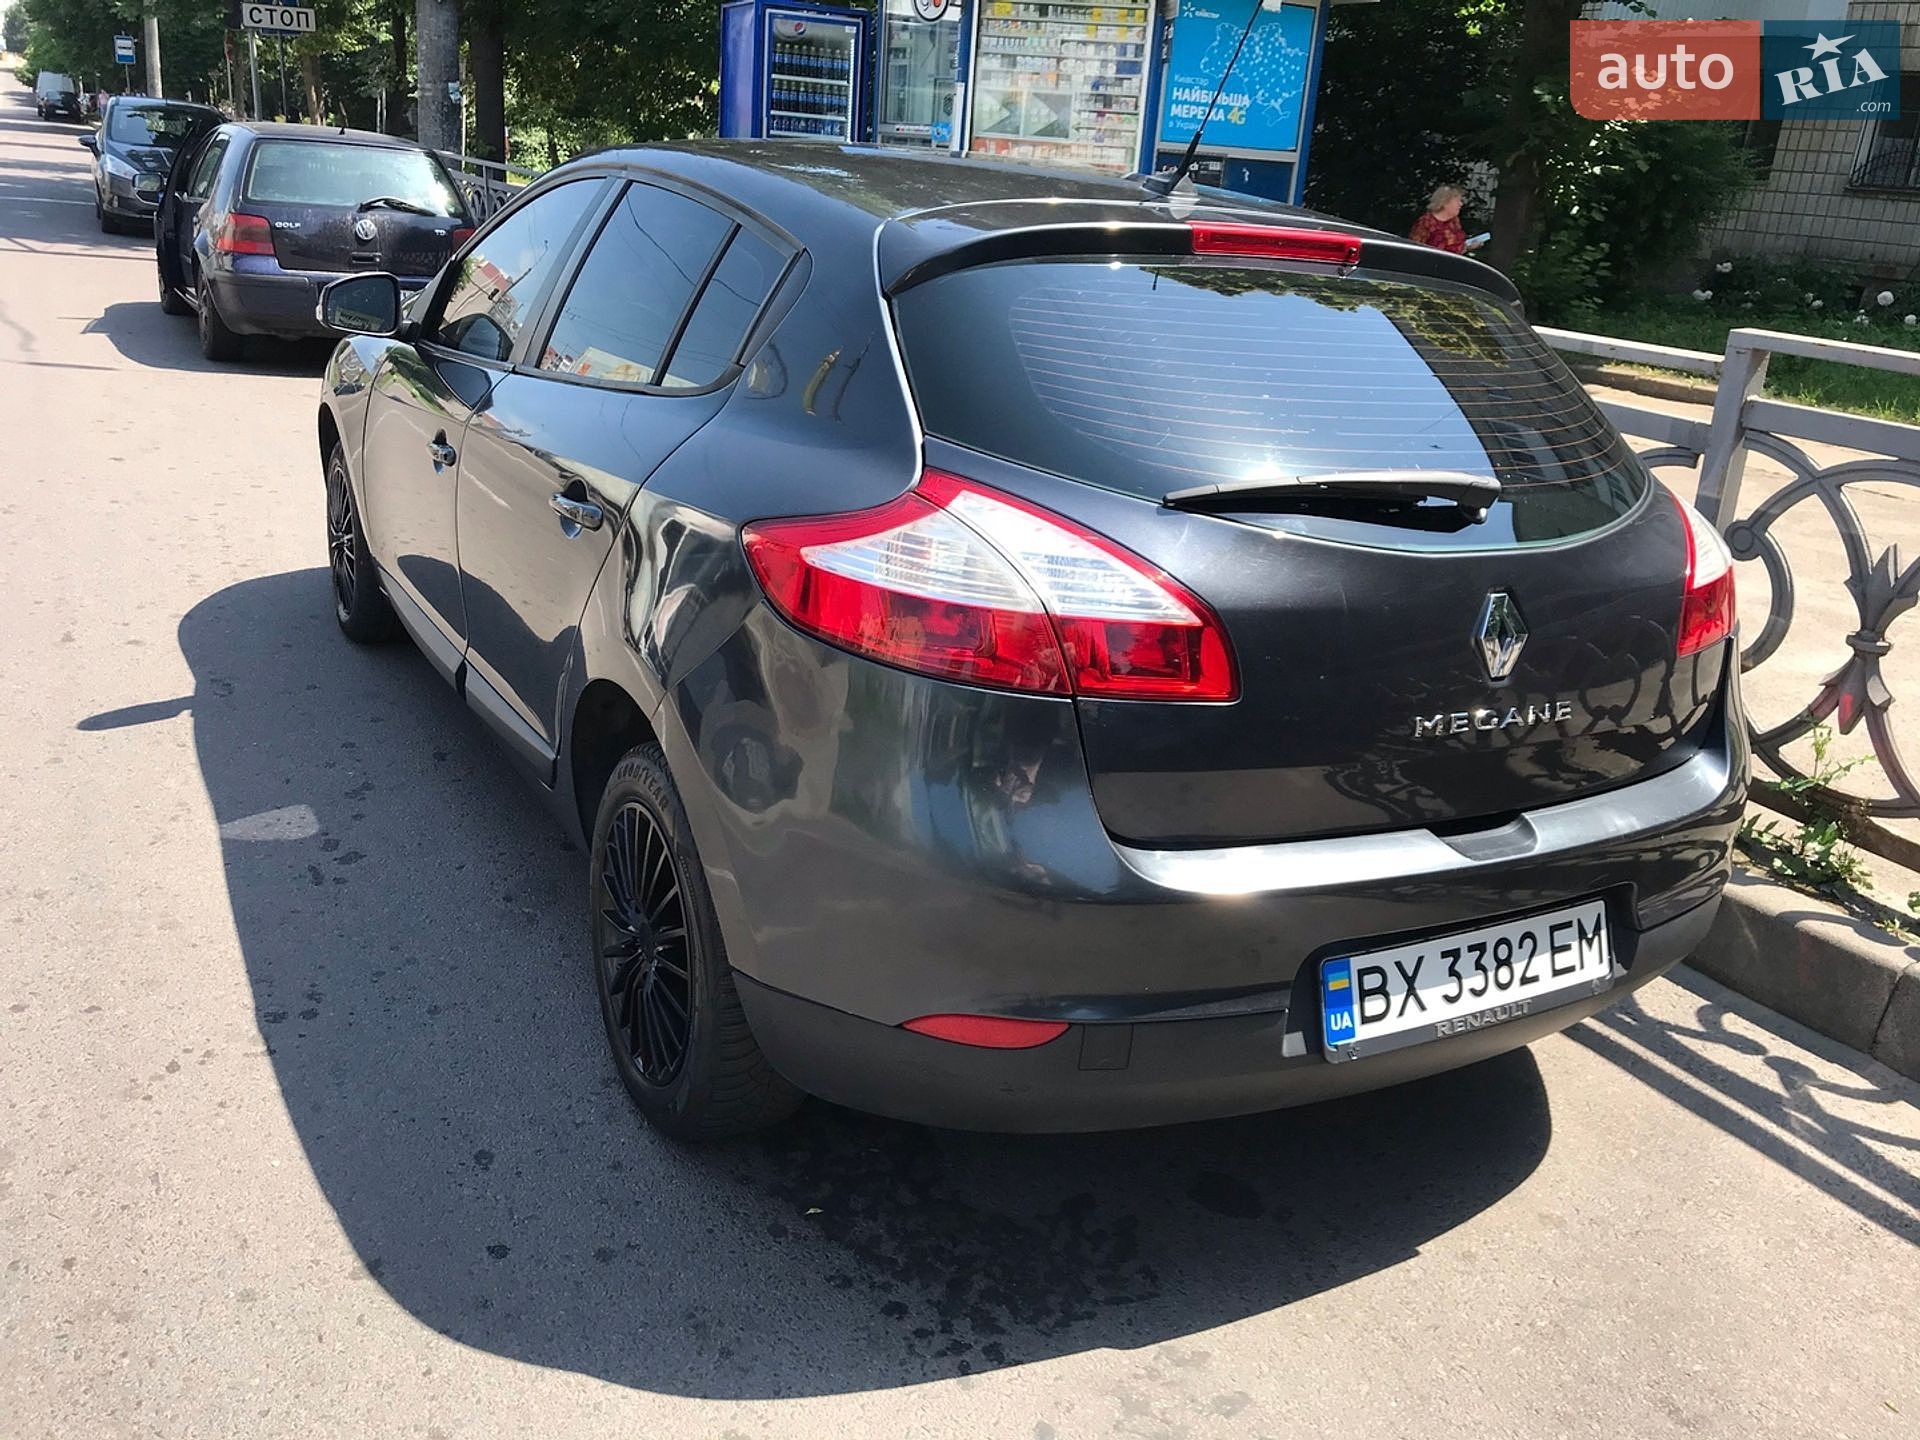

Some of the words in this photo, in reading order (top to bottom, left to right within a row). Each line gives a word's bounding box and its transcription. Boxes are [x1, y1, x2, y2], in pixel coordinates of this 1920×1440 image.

[249, 6, 310, 28] СТОП
[1227, 107, 1247, 125] 4G
[274, 221, 302, 229] GOLF
[1414, 700, 1573, 738] MEGANE
[1356, 954, 1428, 1026] BX
[1440, 931, 1541, 1005] 3382
[1548, 912, 1604, 979] EM
[1329, 1010, 1354, 1031] UA
[1434, 999, 1533, 1038] RENAULT
